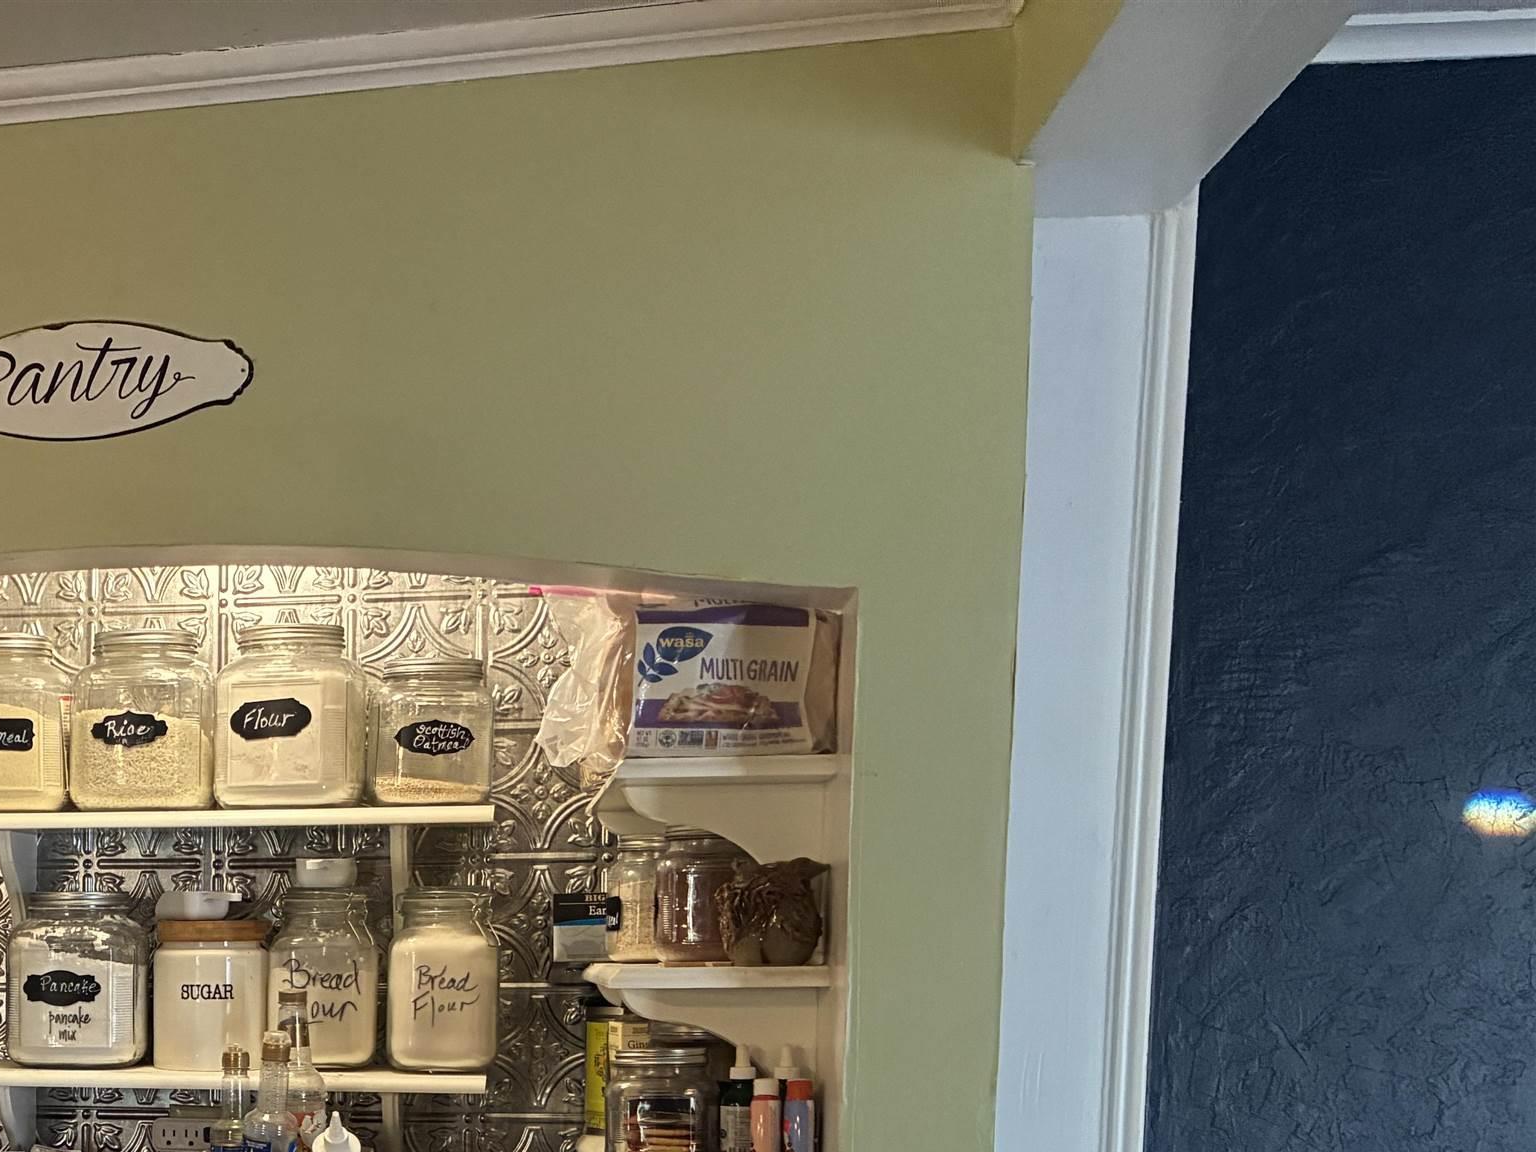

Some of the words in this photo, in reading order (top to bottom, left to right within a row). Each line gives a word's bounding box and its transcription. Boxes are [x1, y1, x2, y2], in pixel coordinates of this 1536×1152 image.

[659, 635, 705, 648] wasa
[699, 657, 744, 681] MULTI
[746, 660, 799, 682] GRAIN
[105, 719, 152, 739] Rice
[243, 708, 297, 730] Flour
[588, 905, 607, 916] Ear
[282, 958, 361, 995] Bread
[416, 965, 479, 993] Bread
[181, 984, 234, 1000] SUGAR
[49, 1006, 91, 1034] pancake
[412, 991, 480, 1029] Flour
[58, 1029, 77, 1041] mix
